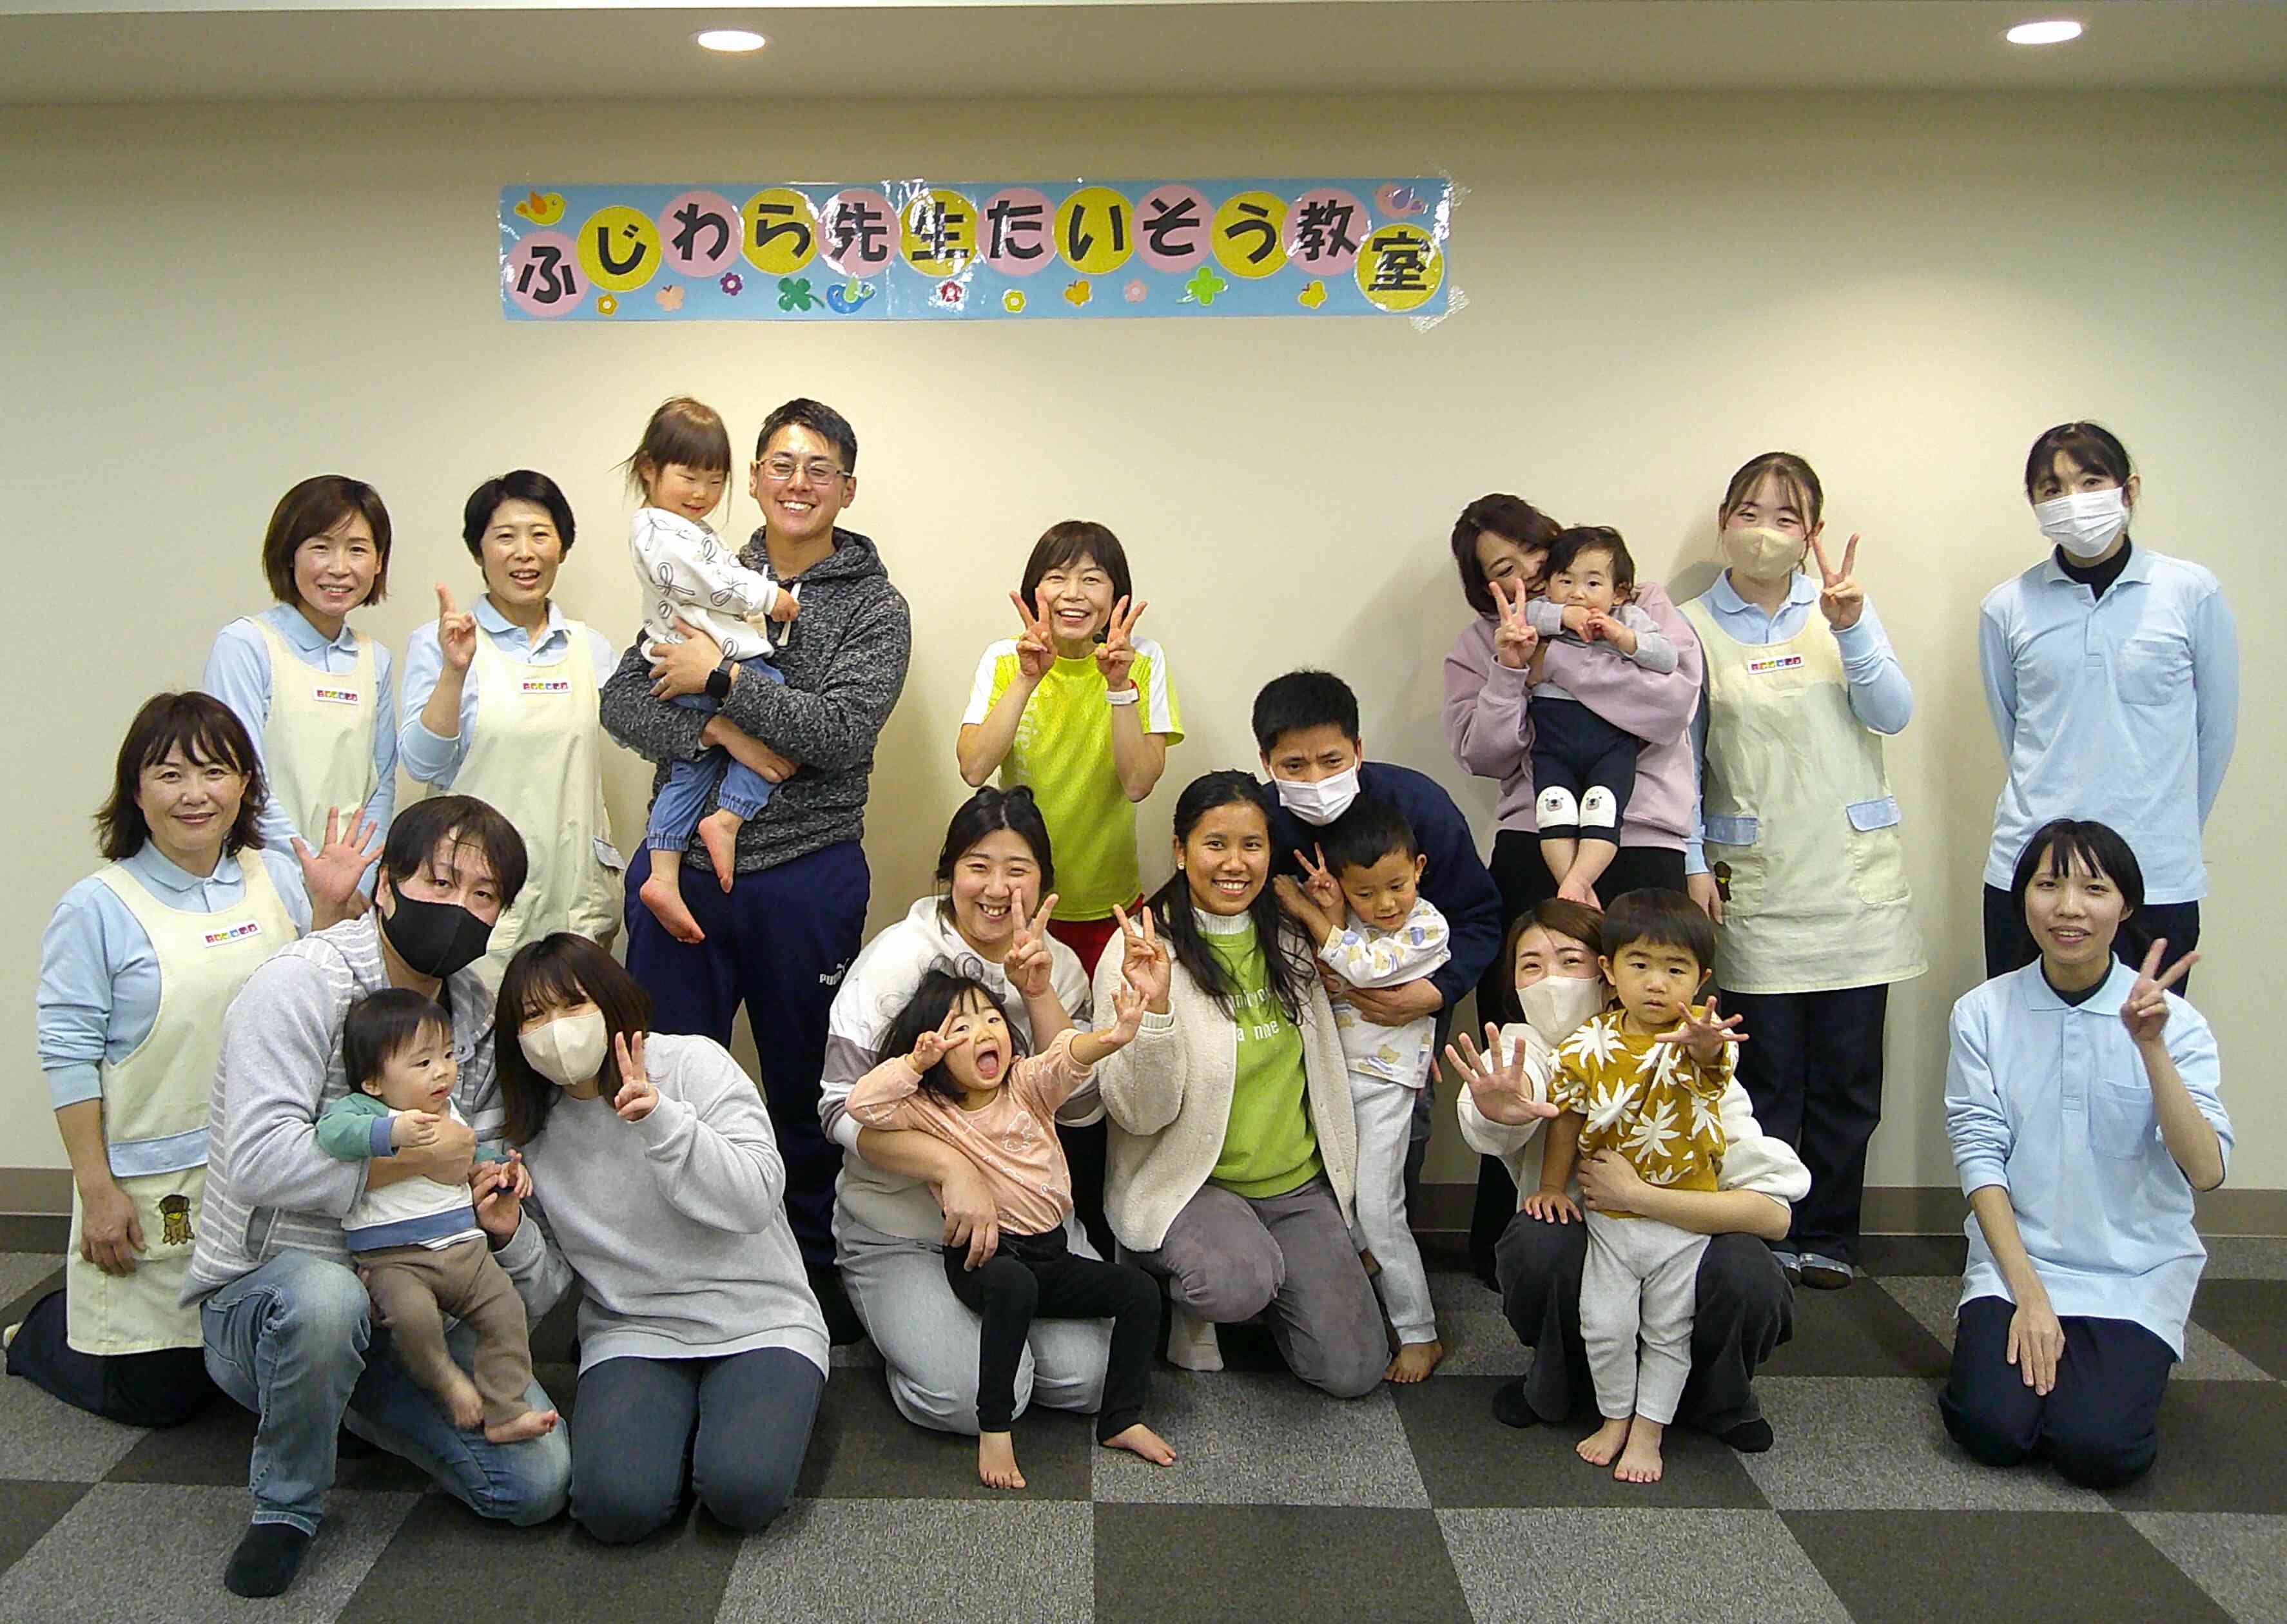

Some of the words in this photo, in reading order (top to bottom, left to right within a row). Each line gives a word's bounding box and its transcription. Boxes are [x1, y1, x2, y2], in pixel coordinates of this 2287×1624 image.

[516, 197, 1430, 304] ふじわら先生たいそう教室
